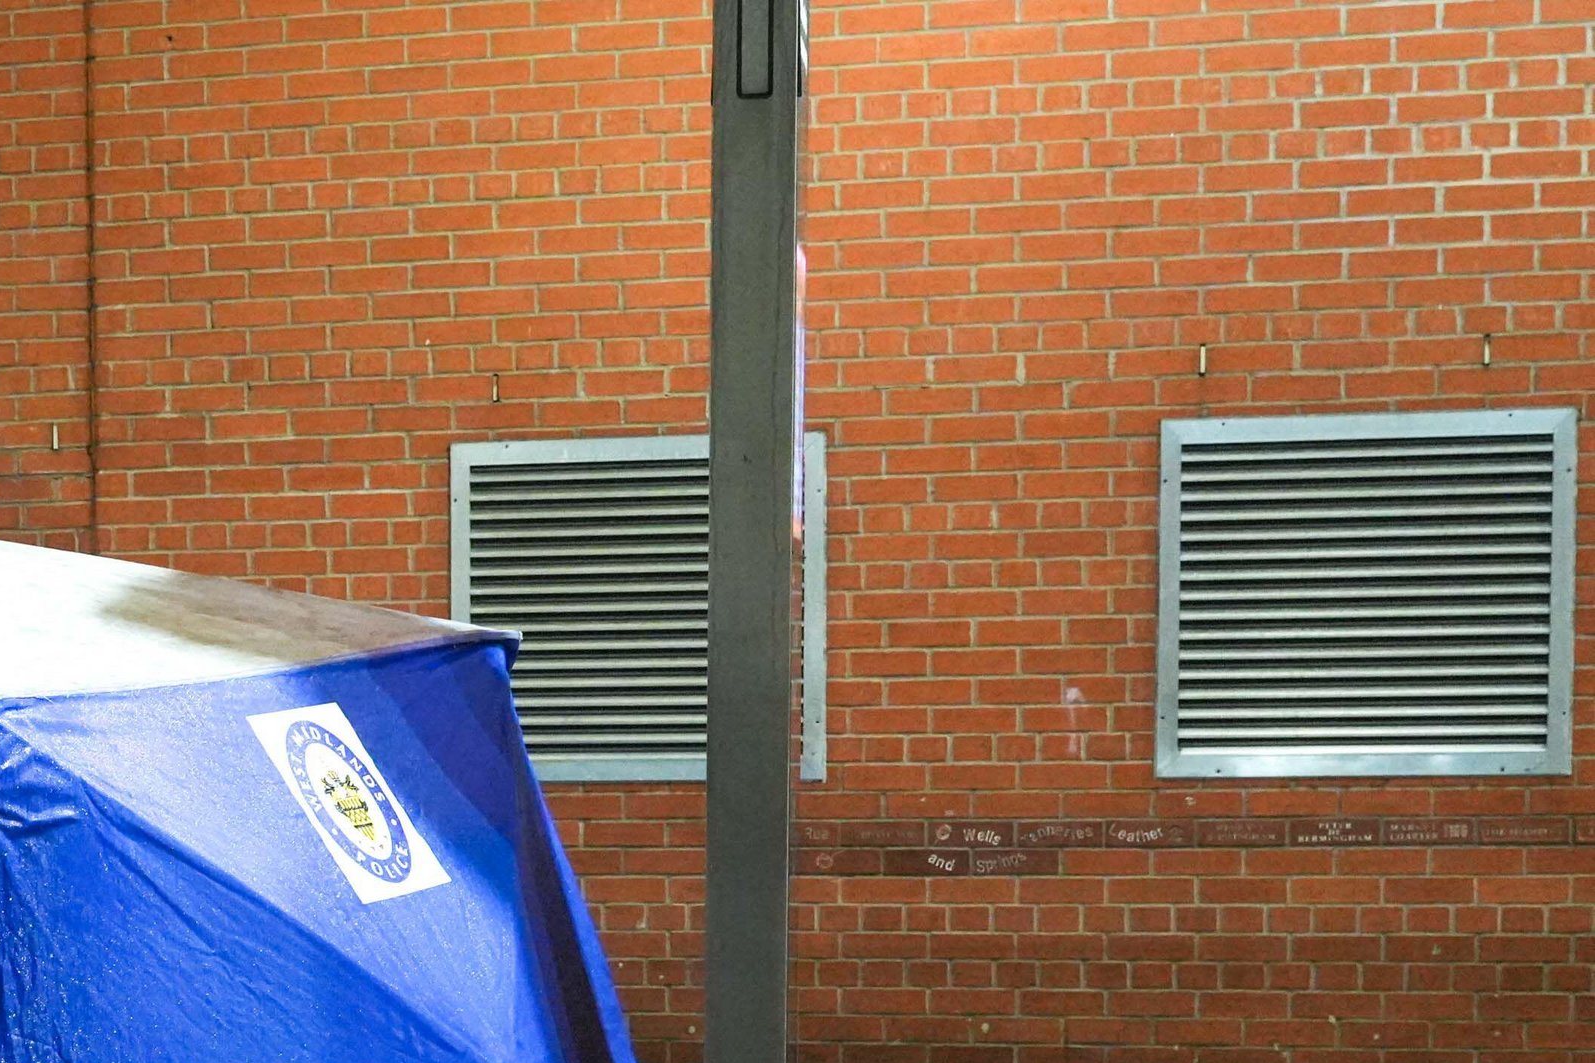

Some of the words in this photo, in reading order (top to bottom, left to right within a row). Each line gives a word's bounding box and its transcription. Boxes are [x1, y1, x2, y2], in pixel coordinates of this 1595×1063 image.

[292, 725, 386, 802] MIDLANDS
[291, 753, 323, 813] WEST
[963, 828, 1002, 846] Wells
[1108, 822, 1165, 843] Leather
[356, 841, 409, 880] POLICE
[927, 853, 956, 871] and
